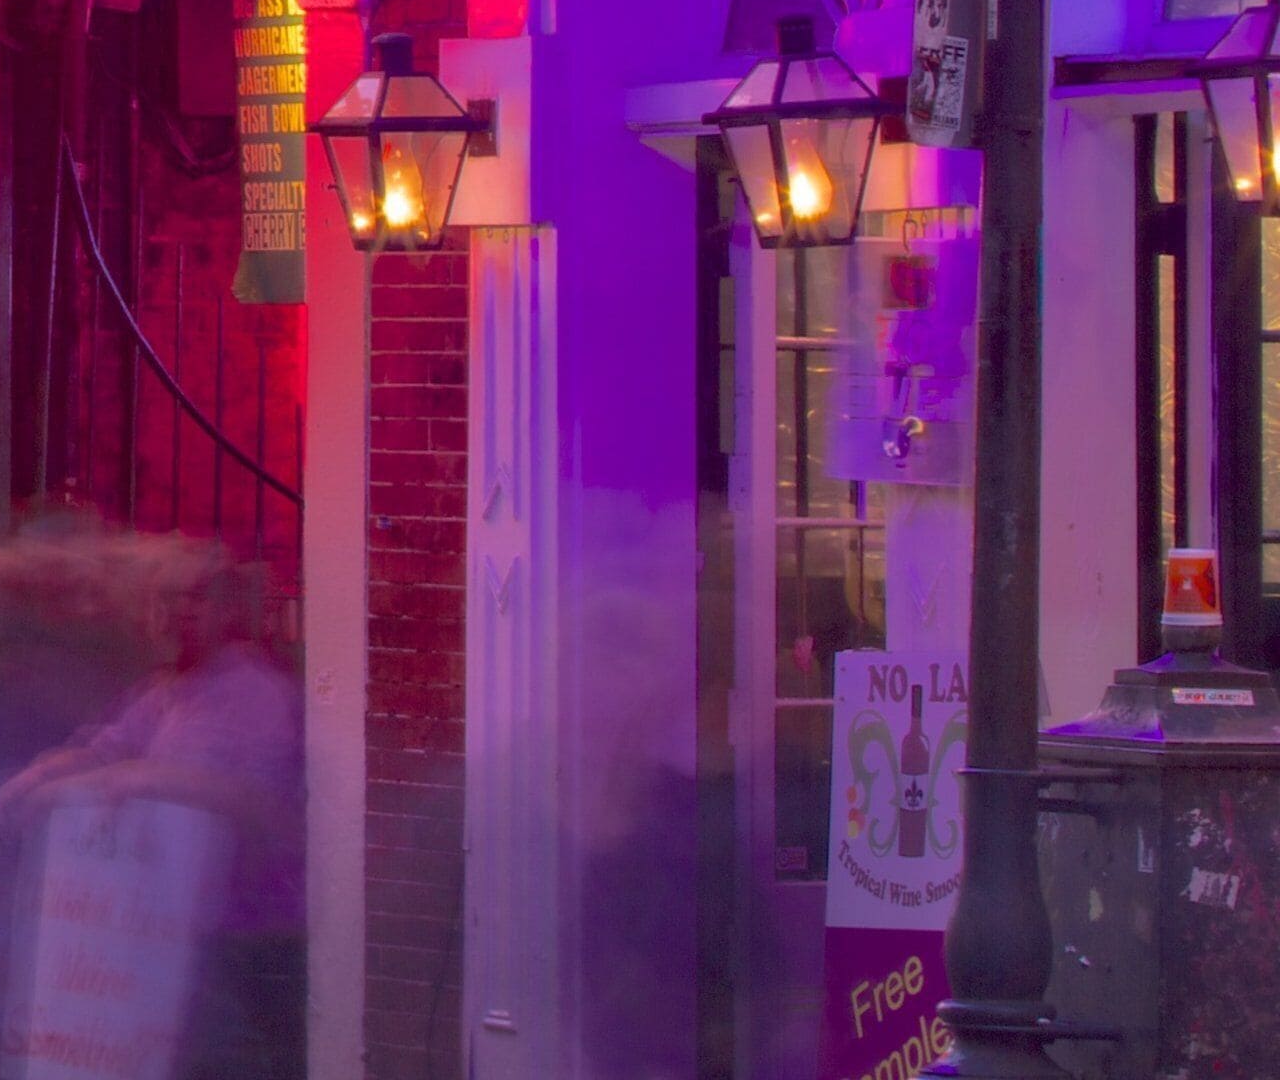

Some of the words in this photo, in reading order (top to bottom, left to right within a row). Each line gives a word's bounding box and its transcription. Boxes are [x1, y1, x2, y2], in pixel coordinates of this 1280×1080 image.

[234, 24, 306, 58] HURRICANE
[240, 104, 268, 134] FISH
[243, 143, 282, 173] SHOTS
[244, 212, 295, 251] CHERRY
[839, 839, 887, 900] Tropical
[890, 882, 922, 907] Wine
[851, 956, 925, 1040] Free
